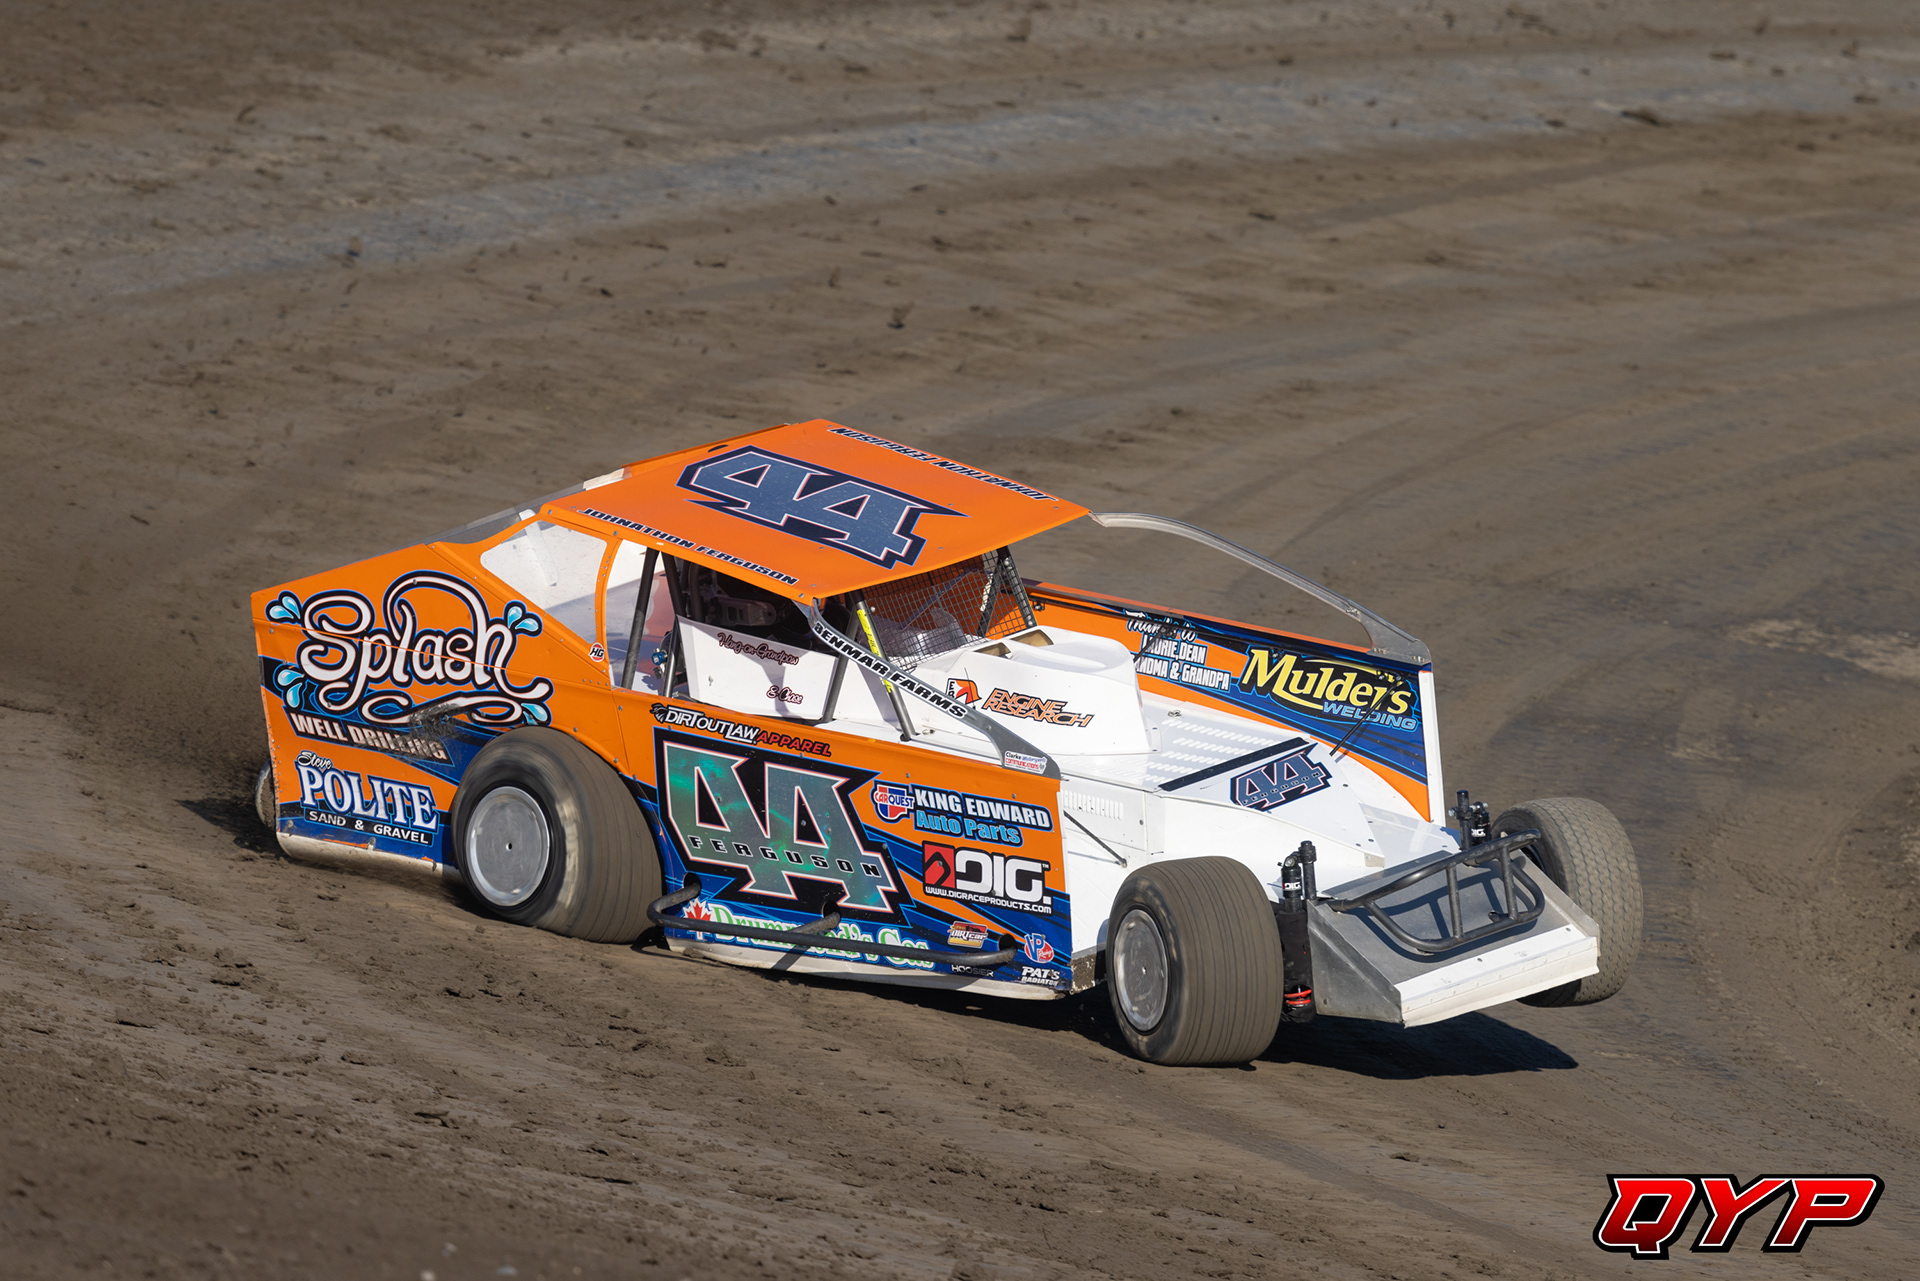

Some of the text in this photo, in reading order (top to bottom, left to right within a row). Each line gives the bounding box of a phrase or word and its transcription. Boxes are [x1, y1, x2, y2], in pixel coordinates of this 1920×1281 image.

[827, 427, 1059, 502] JOHNATHON FERGUSON
[686, 449, 926, 567] 44
[576, 508, 799, 586] JOHNATHON FERGUSON
[299, 575, 551, 723] Splash
[589, 647, 605, 657] HG
[812, 621, 890, 677] BENMAR
[890, 667, 968, 719] FARMS
[1169, 661, 1180, 680] &
[1181, 664, 1231, 691] GRANDPA
[982, 699, 1094, 727] RESEARCH
[989, 688, 1067, 713] ENGINE
[1323, 701, 1418, 730] WELDING
[289, 712, 348, 742] WELL
[297, 750, 334, 771] Steve
[756, 731, 832, 758] APPAREL
[1234, 749, 1327, 810] 44
[300, 765, 438, 831] POLITE
[873, 791, 914, 808] CARQUEST
[914, 788, 1051, 828] KING EDWARD
[309, 810, 429, 845] SAND & GRAVEL
[662, 740, 900, 914] 44
[916, 809, 1020, 844] Auto Parts
[688, 836, 882, 877] FERGUSON
[1024, 933, 1045, 962] VP
[951, 964, 994, 978] HOOSIER
[1022, 966, 1061, 981] PAT'S
